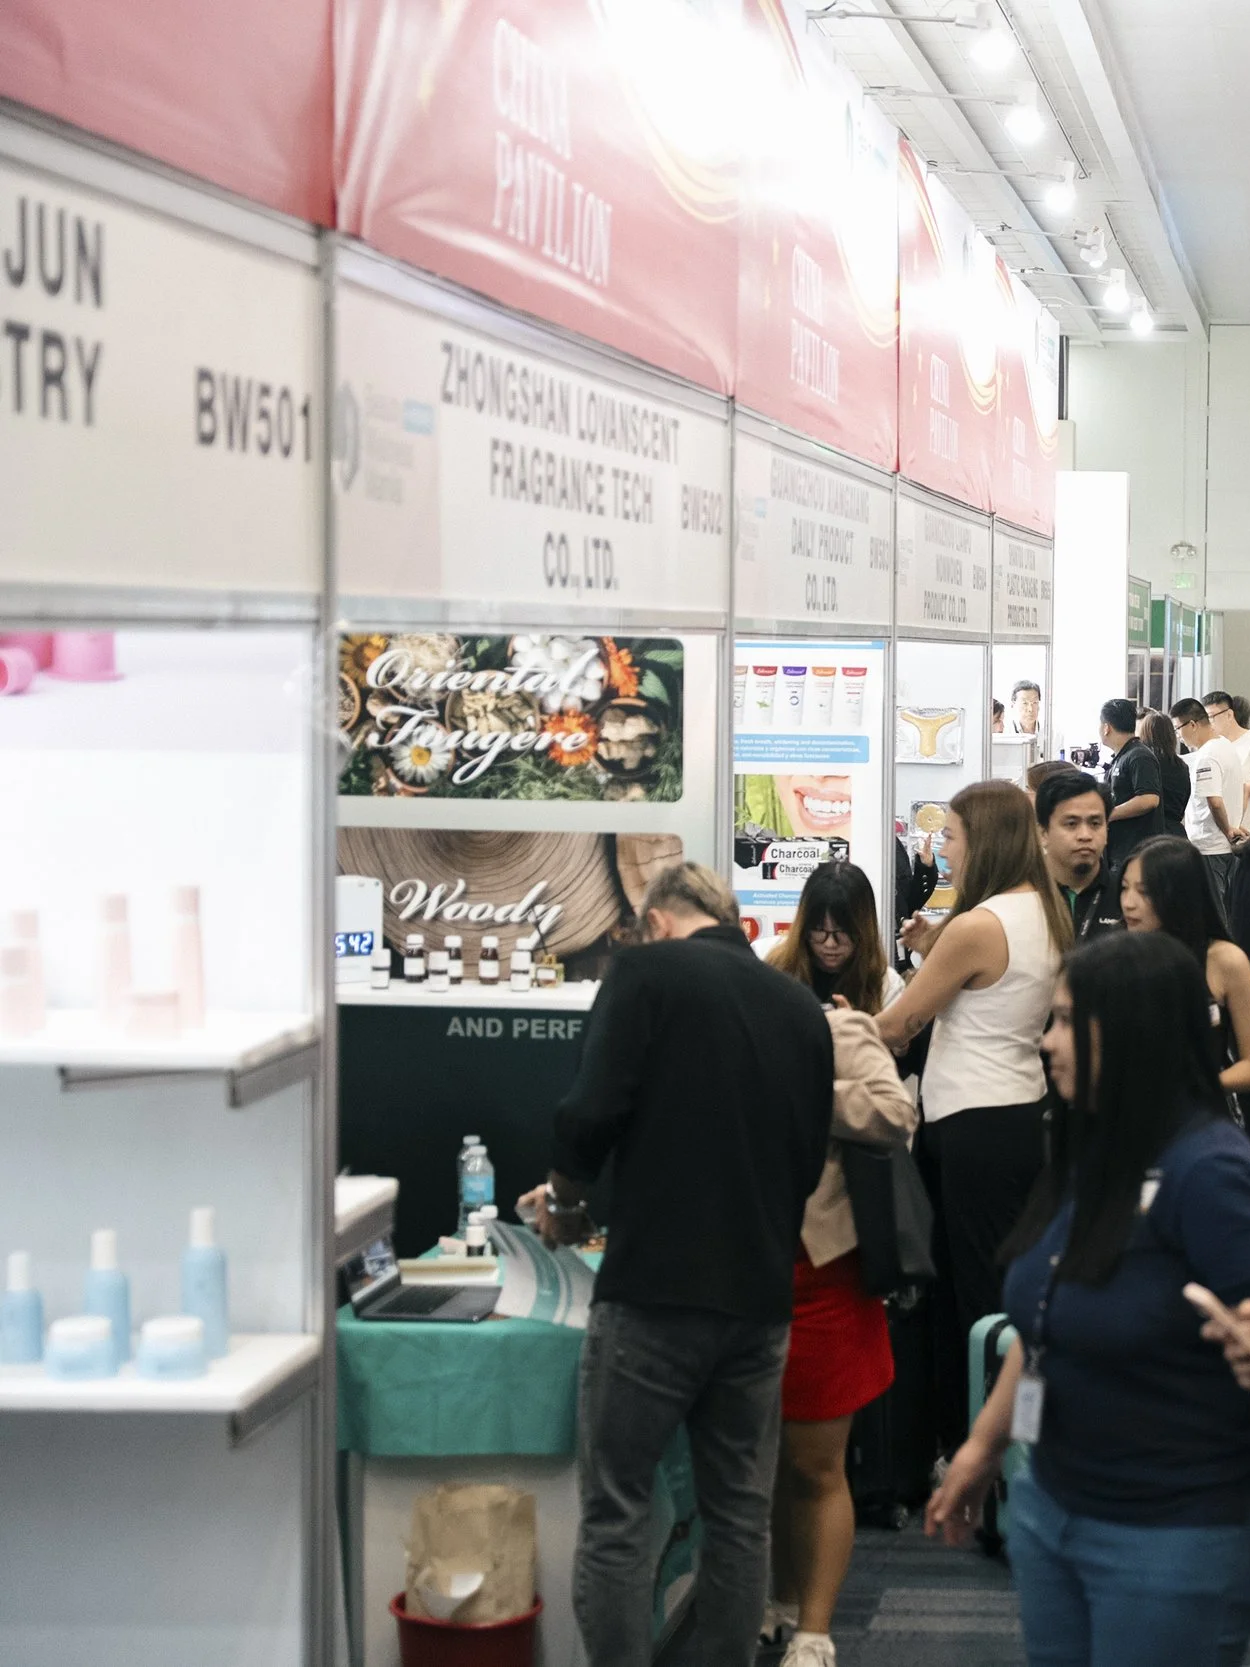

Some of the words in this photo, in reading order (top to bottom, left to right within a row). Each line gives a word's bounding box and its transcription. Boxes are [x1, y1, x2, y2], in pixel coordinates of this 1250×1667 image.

[492, 130, 611, 287] PAVILION
[4, 196, 103, 308] JUN
[4, 320, 103, 428] TRY
[441, 340, 570, 437] ZHONGSHAN
[577, 386, 680, 465] LOVANSCENT
[790, 318, 840, 404] PAVILION
[195, 365, 312, 464] BW501
[489, 437, 605, 516] FRAGRANCE
[611, 467, 653, 524] TECH
[681, 484, 721, 535] BW502
[791, 517, 815, 557] DAILY
[817, 524, 854, 565] PRODUCT
[366, 648, 600, 692] Oriental
[366, 705, 590, 785] Fougere
[771, 848, 820, 859] Charcoal
[389, 878, 563, 948] Woody
[447, 1017, 503, 1038] AND
[512, 1018, 583, 1040] PERF
